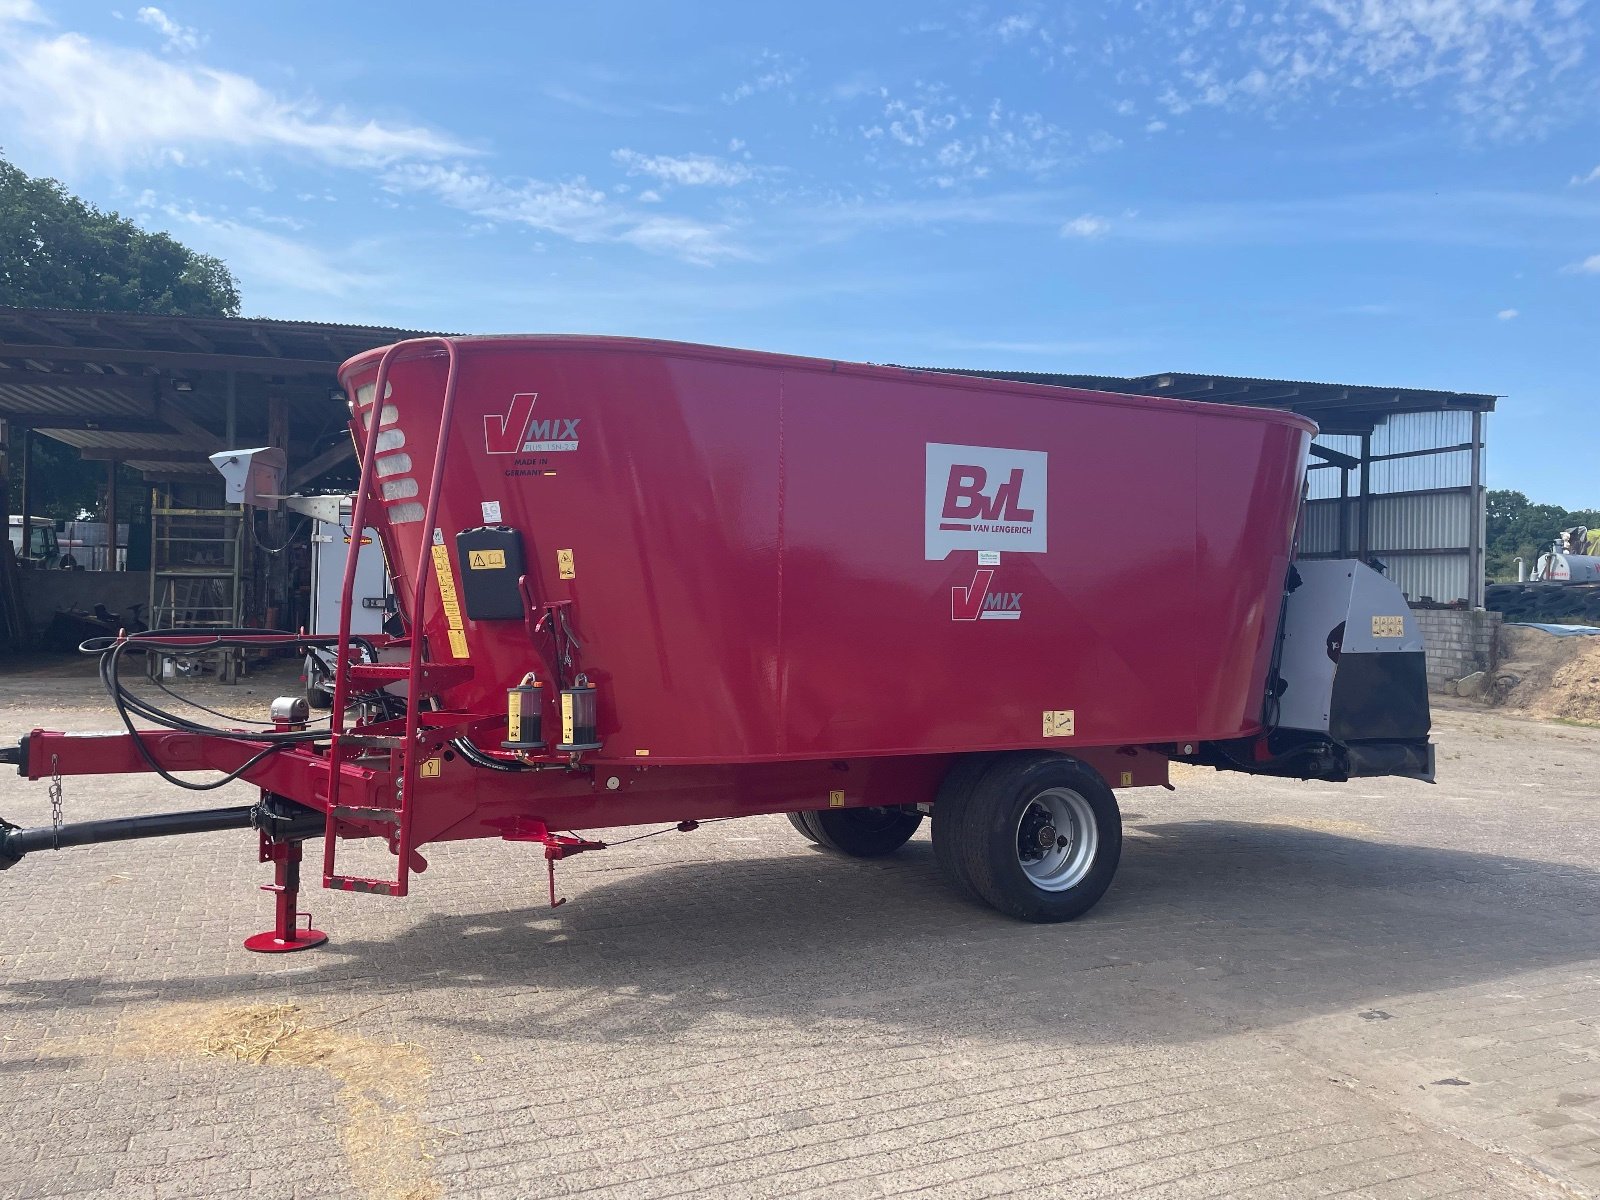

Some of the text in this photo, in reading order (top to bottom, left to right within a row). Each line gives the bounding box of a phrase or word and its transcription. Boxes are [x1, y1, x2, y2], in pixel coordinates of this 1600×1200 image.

[526, 418, 581, 440] MIX
[525, 443, 542, 452] PLUS
[514, 458, 537, 466] MADE
[505, 469, 542, 477] GERMANY
[973, 524, 1032, 535] VAN LENGERICH
[983, 592, 1024, 610] MIX
